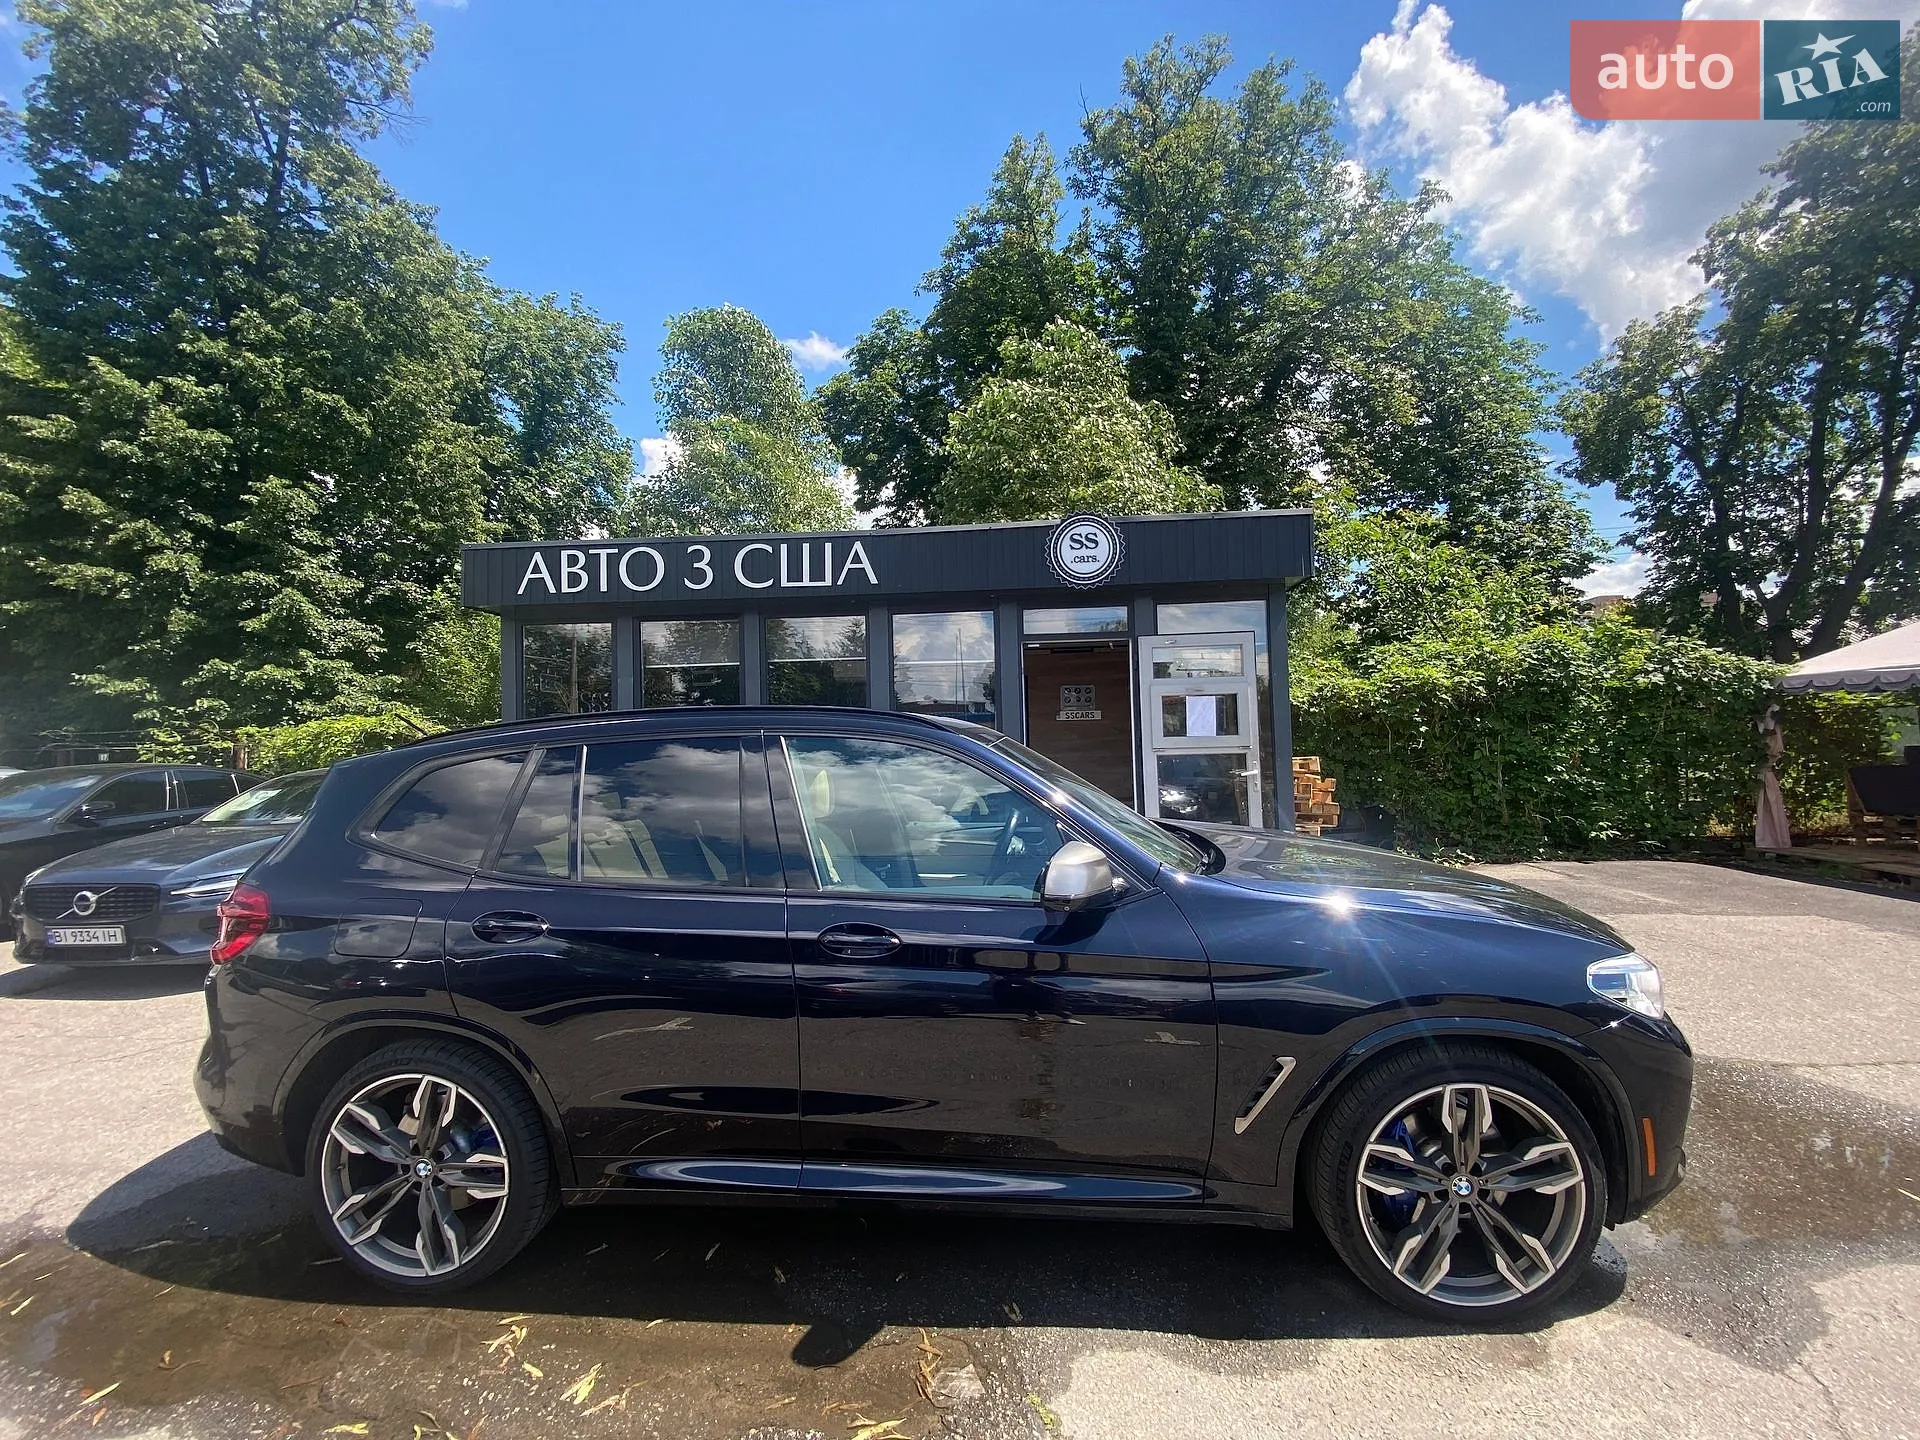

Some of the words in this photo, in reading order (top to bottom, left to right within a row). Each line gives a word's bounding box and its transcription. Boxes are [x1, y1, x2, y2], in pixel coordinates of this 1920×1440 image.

[1069, 532, 1099, 550] SS
[516, 547, 665, 595] АВТО
[733, 541, 879, 589] США
[1065, 711, 1095, 719] SSCARS
[71, 929, 99, 943] 9334
